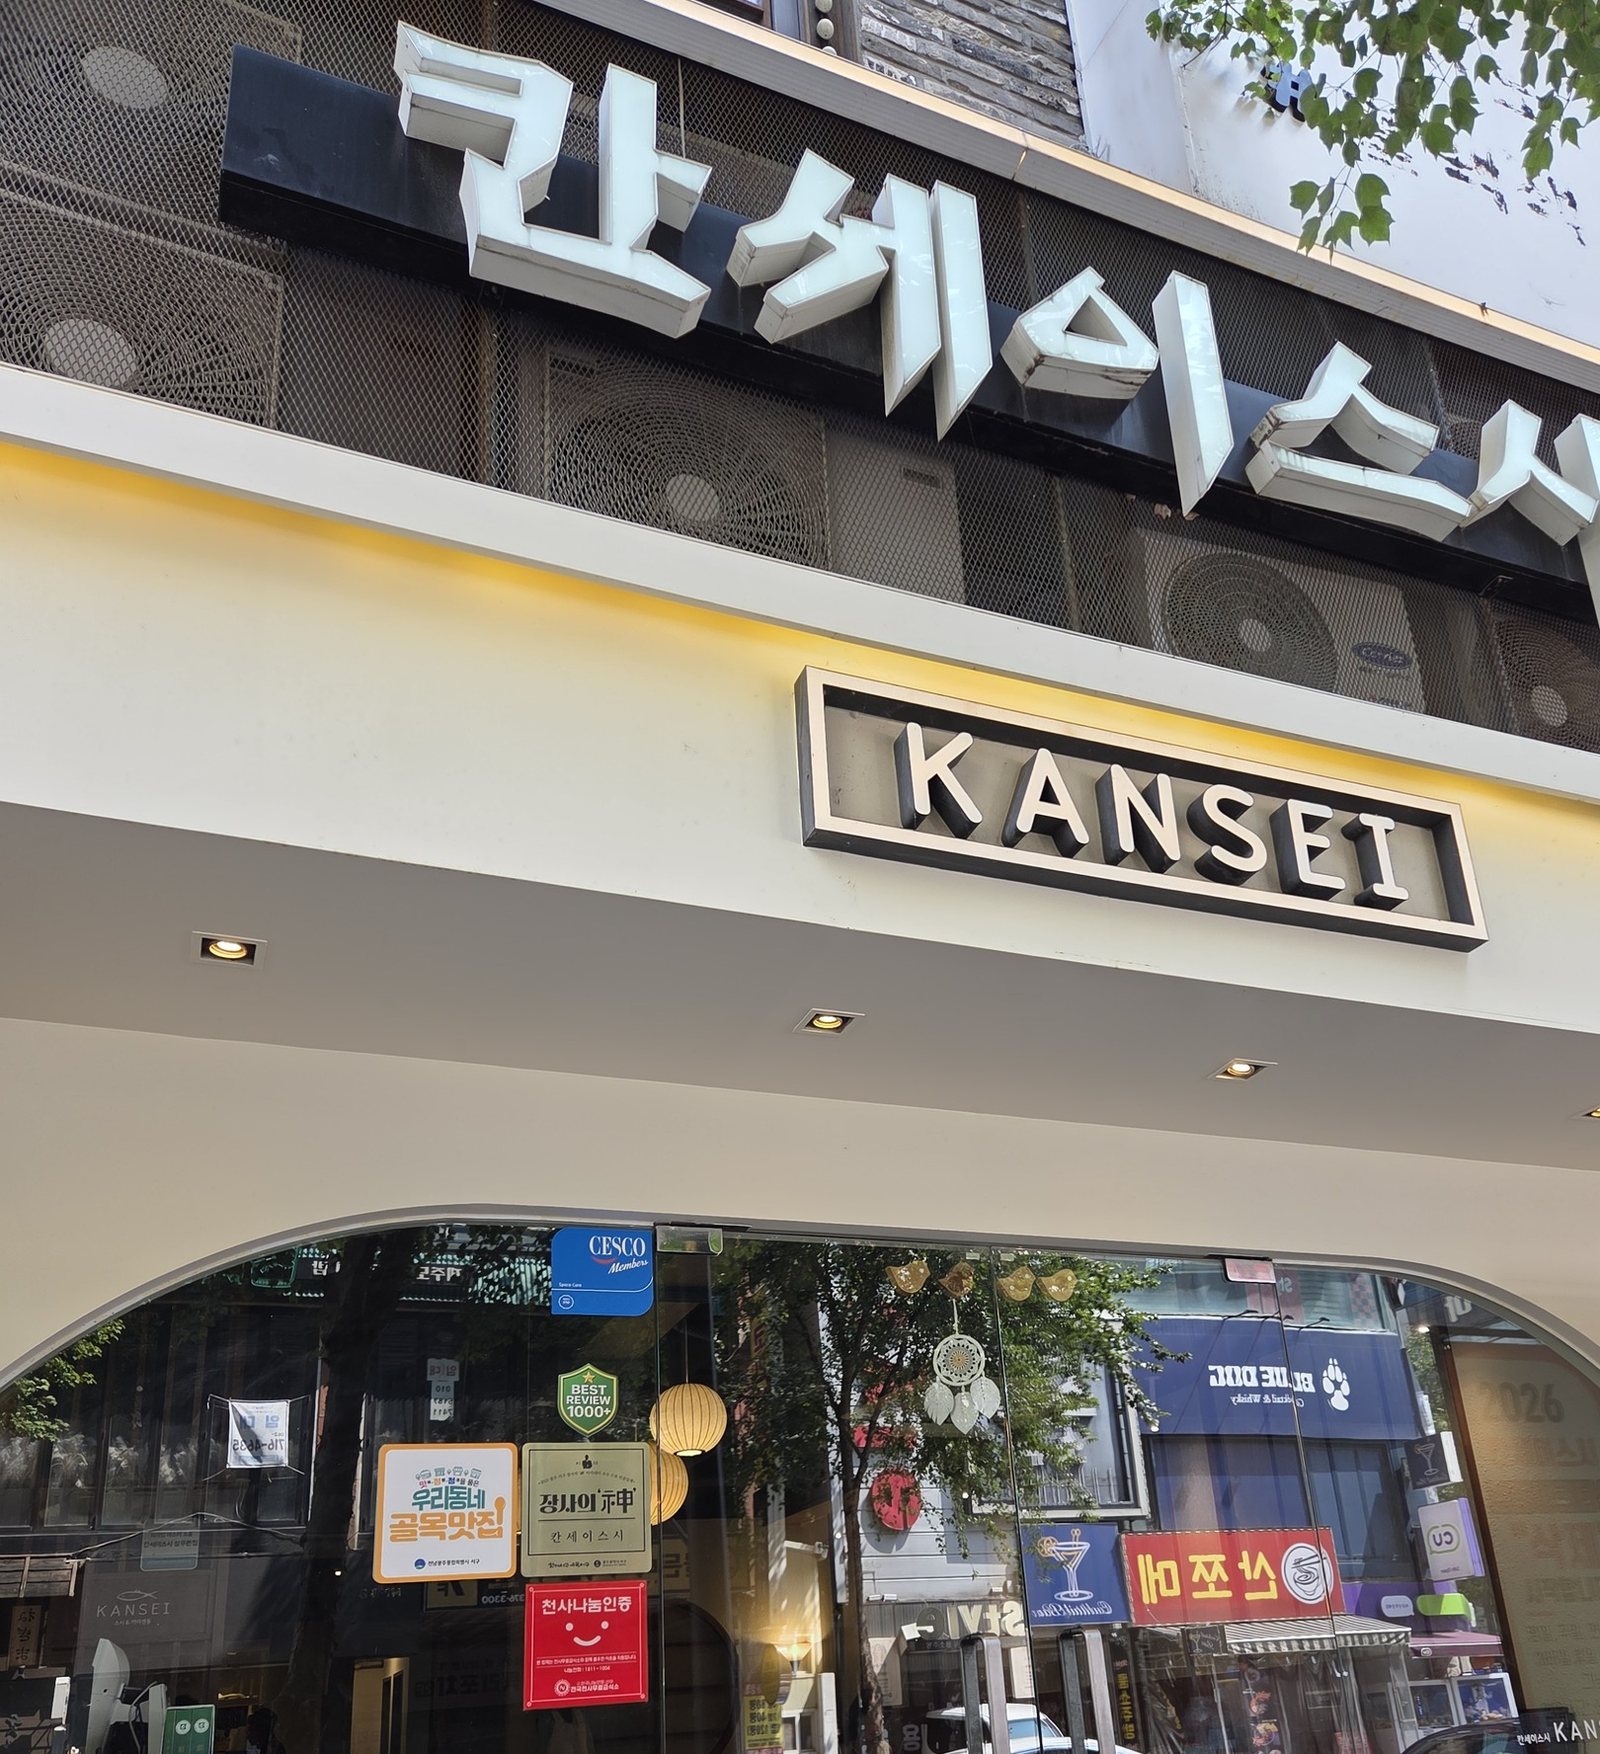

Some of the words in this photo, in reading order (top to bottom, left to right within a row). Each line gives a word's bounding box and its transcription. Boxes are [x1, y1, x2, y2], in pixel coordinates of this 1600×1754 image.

[394, 20, 1600, 610] 칸세이스시
[896, 721, 1409, 910] KANSEI
[589, 1235, 646, 1257] CESCO
[608, 1258, 649, 1274] Members
[571, 1384, 607, 1395] BEST
[566, 1396, 611, 1405] REVIEW
[566, 1405, 611, 1418] 1000+
[412, 1485, 486, 1511] 우리동네
[540, 1493, 596, 1514] 장사의
[389, 1496, 506, 1543] 골목맛집
[551, 1529, 624, 1544] 칸세이스시
[96, 1602, 171, 1618] KANSEI
[542, 1596, 632, 1615] 천사나눔인증
[1516, 1731, 1552, 1747] 칸세이스시
[1552, 1719, 1600, 1743] KAN
